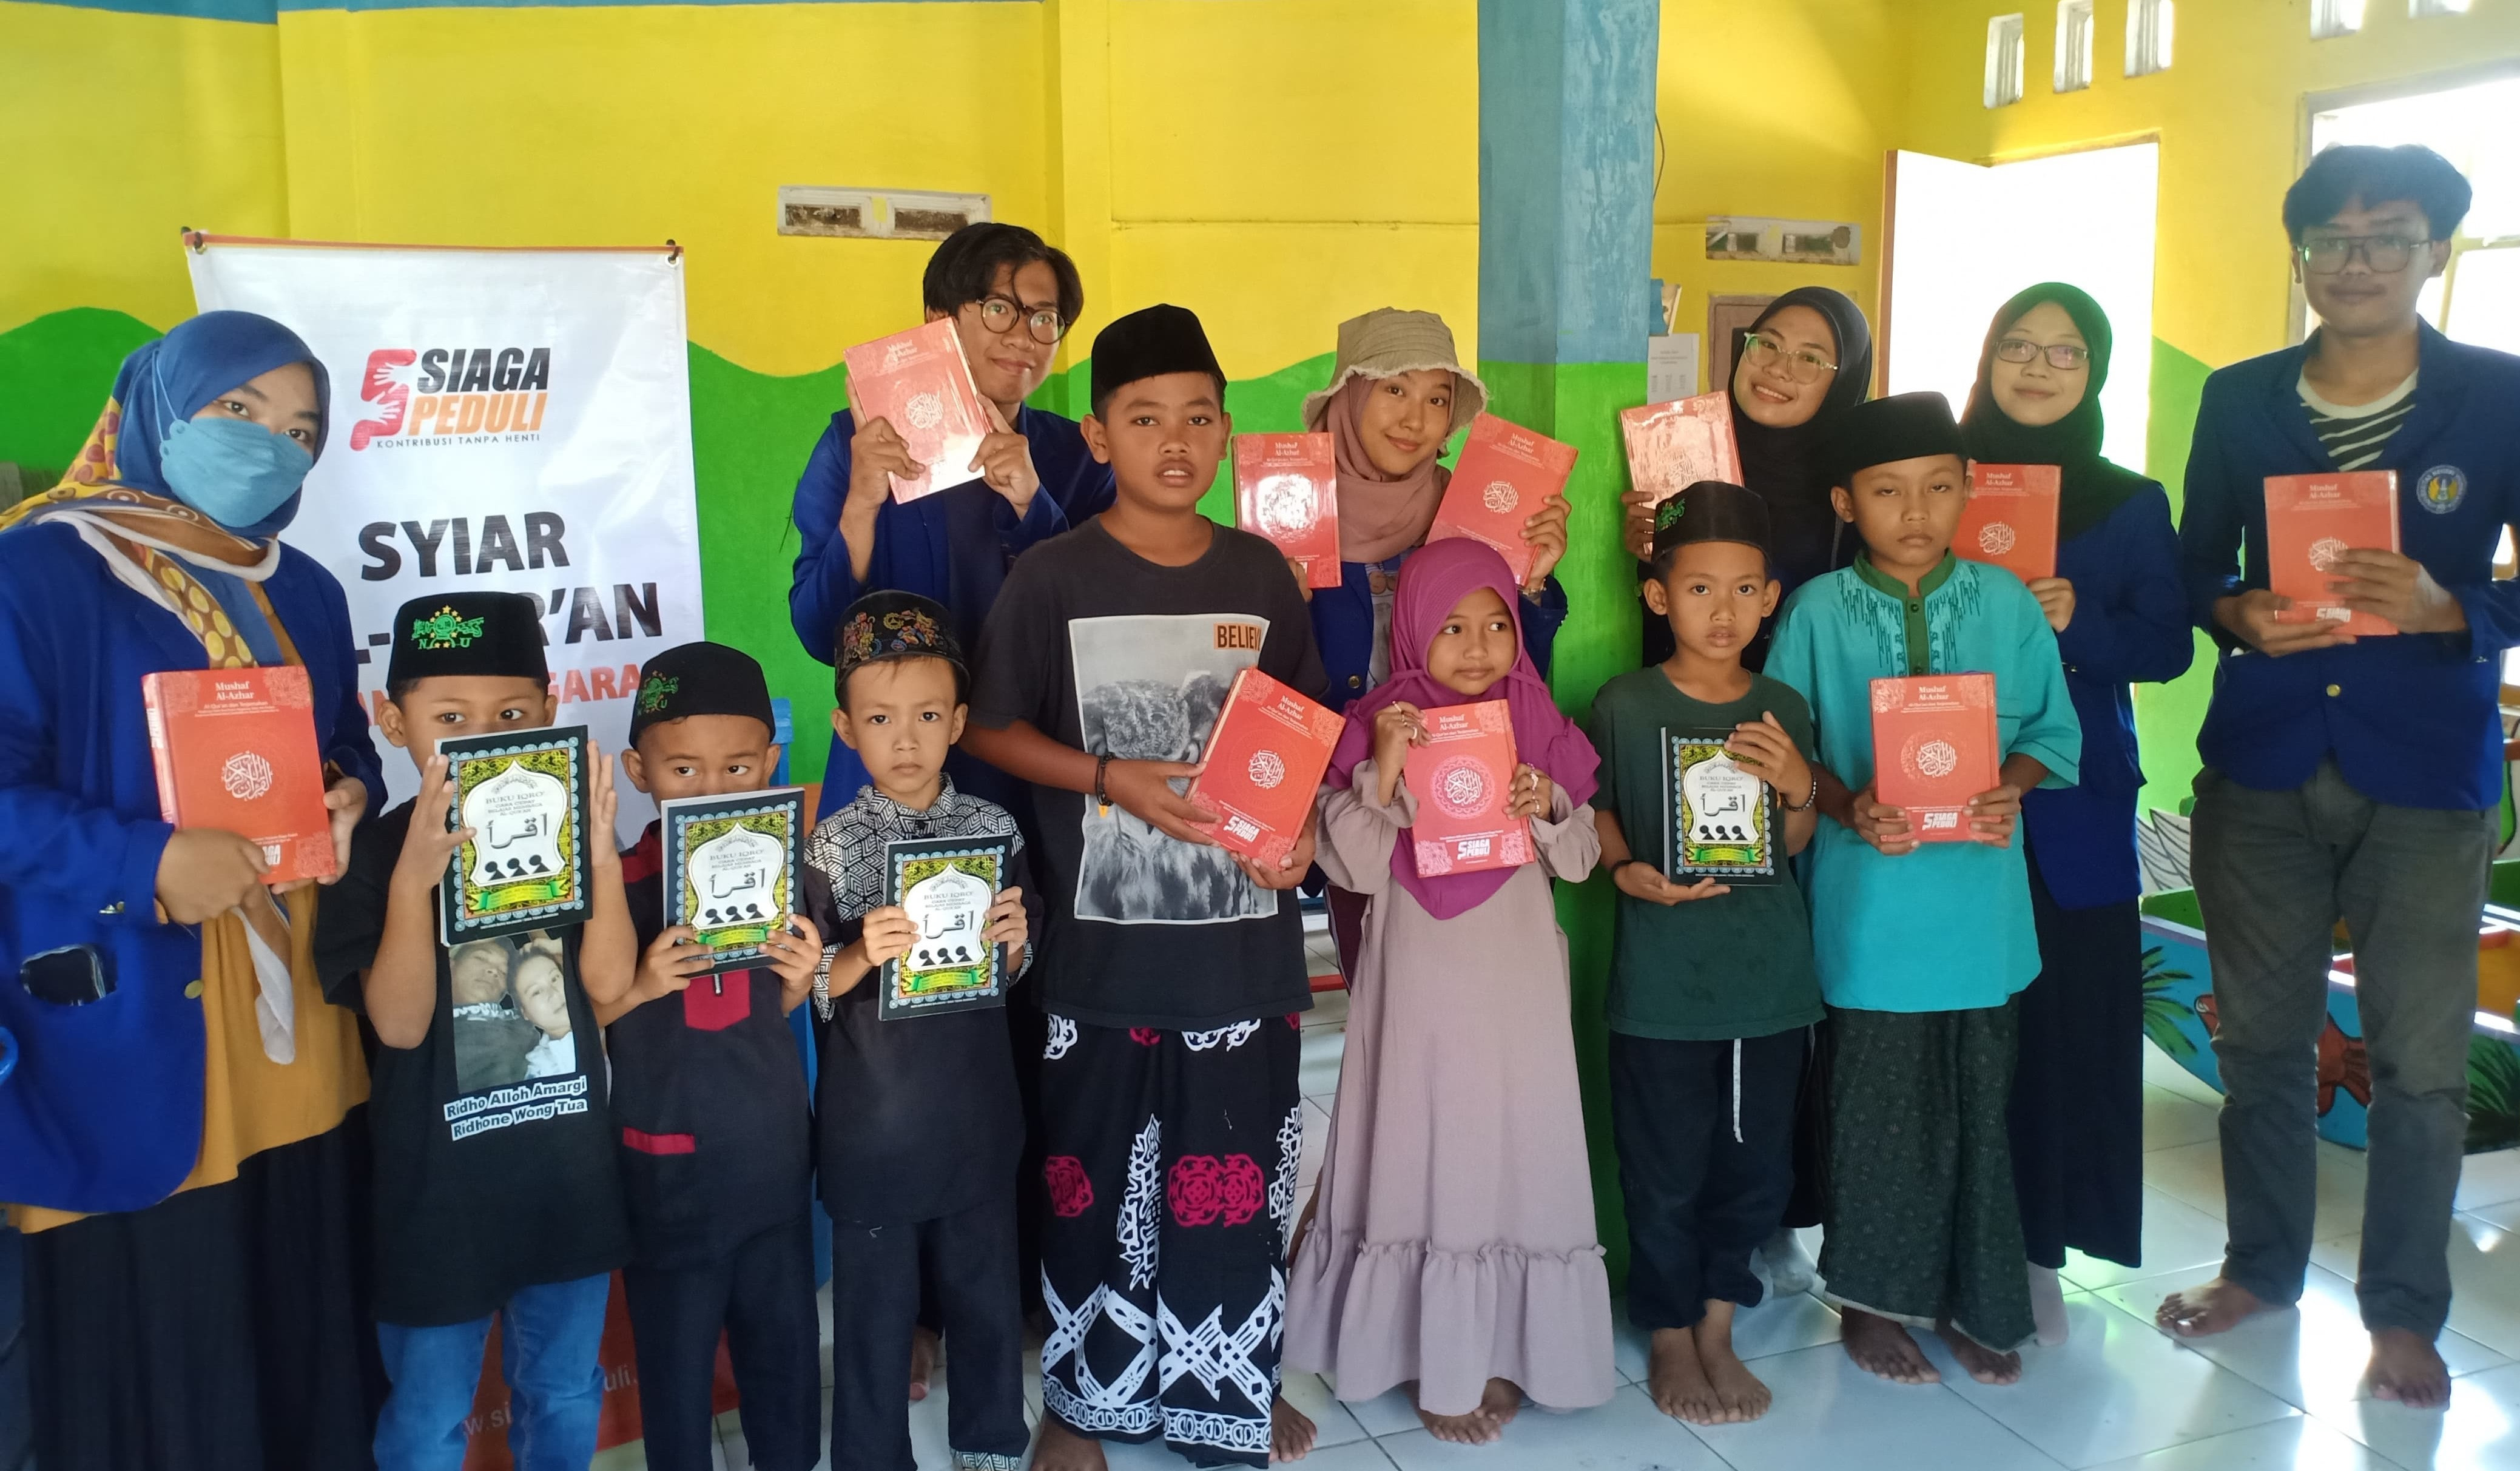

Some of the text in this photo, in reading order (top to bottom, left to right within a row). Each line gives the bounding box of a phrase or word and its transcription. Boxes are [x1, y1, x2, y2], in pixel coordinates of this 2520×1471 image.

[417, 348, 551, 394] SIAGA
[408, 392, 548, 436] PEDULI
[377, 433, 541, 448] KONTRIBUSI TANPA HENTI
[359, 511, 570, 582] SYIAR
[215, 681, 251, 691] Mushaf
[1918, 685, 1947, 693] Mushaf
[215, 691, 255, 701] Al-Azhar
[1277, 702, 1304, 721] Al-Azhar
[1281, 695, 1305, 713] Mushaf
[1438, 713, 1465, 723] Mushaf
[1440, 722, 1469, 731] Al-Azhar
[485, 795, 514, 804] BUKU
[1235, 827, 1256, 843] PEDULI
[1237, 820, 1260, 835] SIAGA
[1467, 838, 1490, 848] SIAGA
[1467, 847, 1490, 857] PEDULI
[446, 1078, 585, 1118] Ridho Alloh Amargi
[454, 1101, 585, 1137] Ridhone Wong Tua
